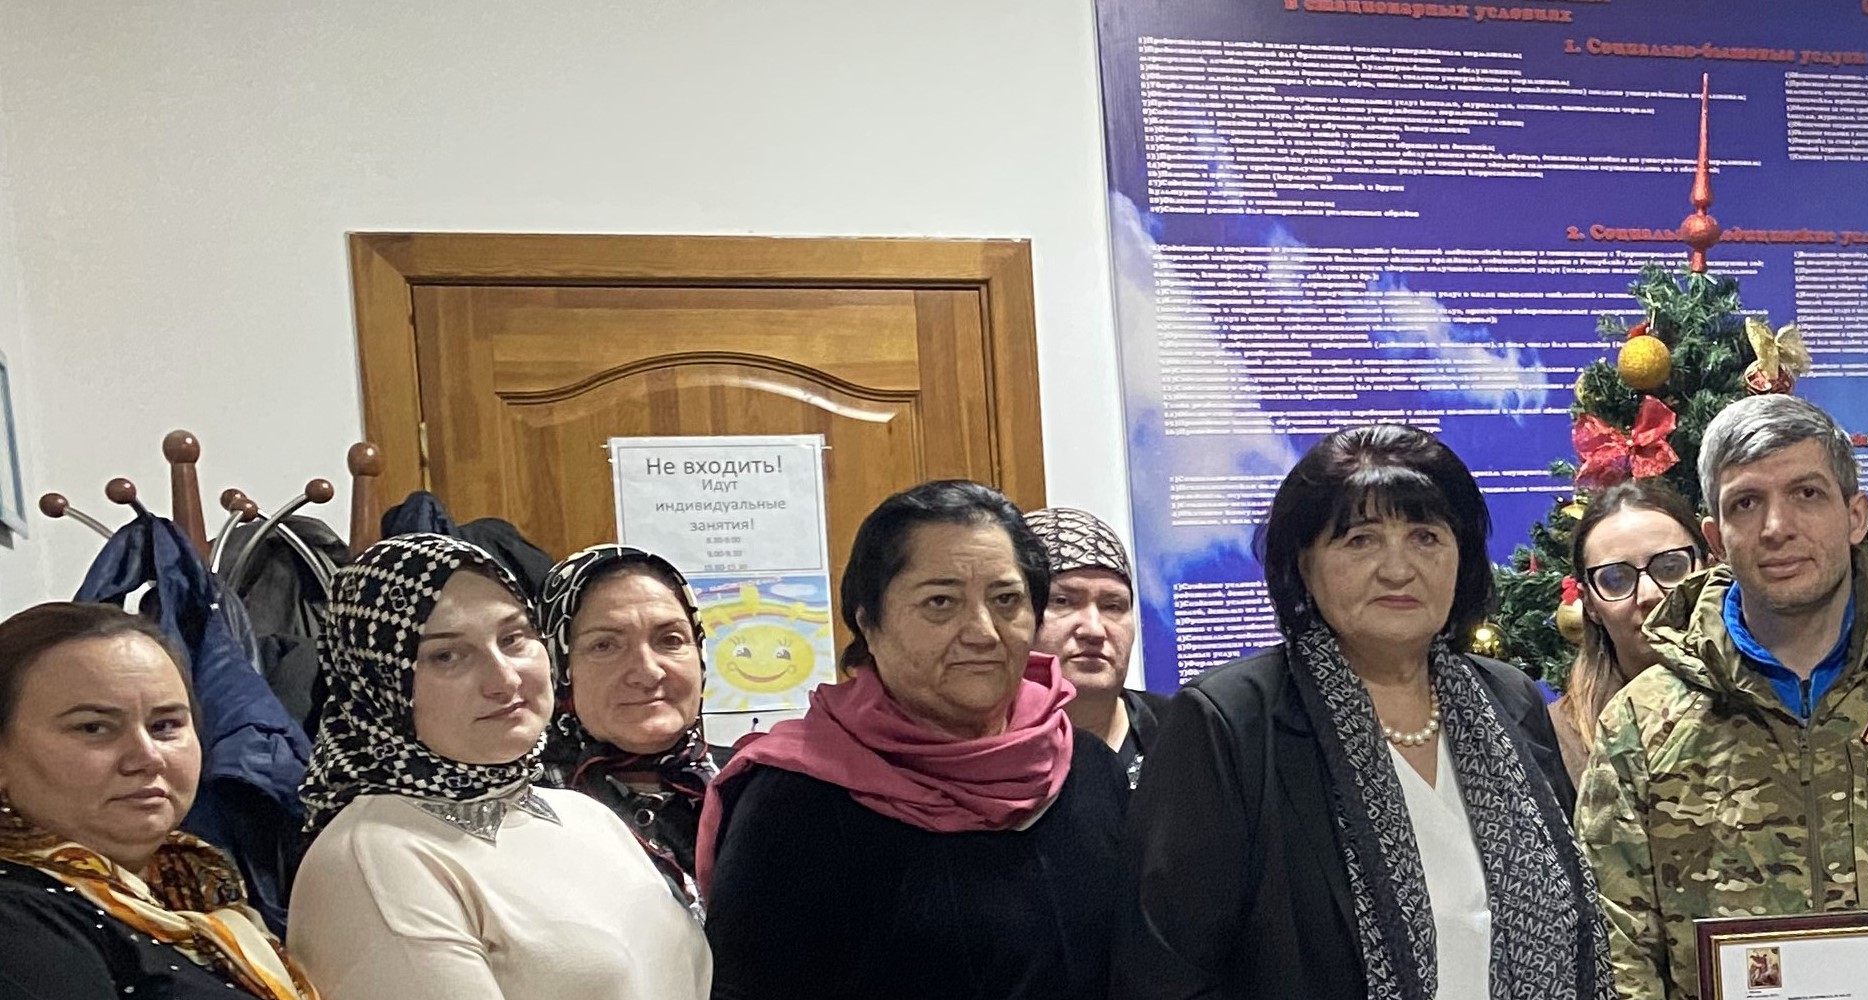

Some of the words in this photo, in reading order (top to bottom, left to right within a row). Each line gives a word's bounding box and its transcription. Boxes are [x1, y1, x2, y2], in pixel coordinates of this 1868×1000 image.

[646, 458, 675, 475] Не
[683, 455, 782, 477] входить!
[702, 478, 738, 492] Идут
[655, 499, 787, 513] индивидуальные
[690, 518, 755, 532] занятия!
